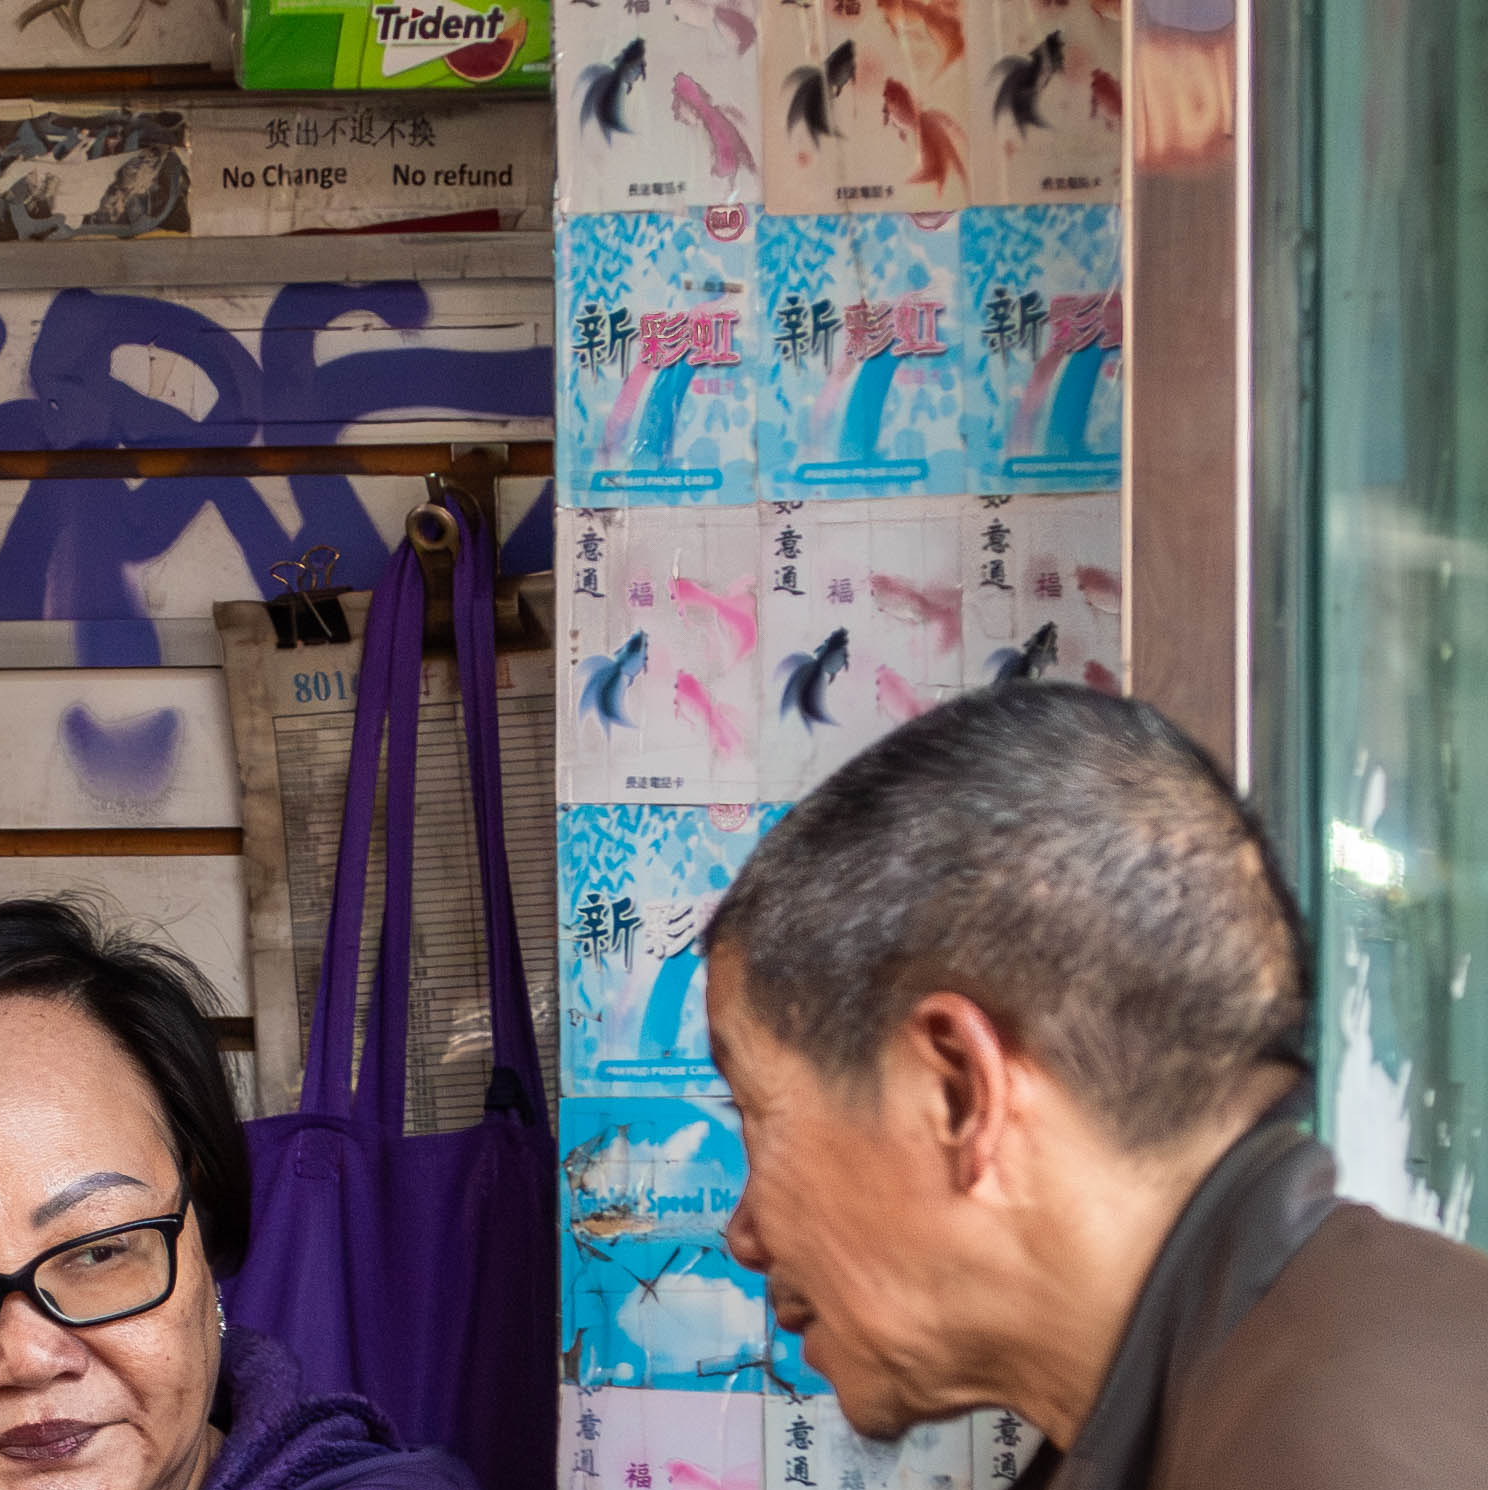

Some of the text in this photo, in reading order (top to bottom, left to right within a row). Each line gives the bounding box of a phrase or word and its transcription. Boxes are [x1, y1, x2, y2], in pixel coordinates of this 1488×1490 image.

[376, 5, 505, 41] Trident
[265, 107, 437, 151] 货出不退不换
[222, 162, 513, 189] No Change No refund
[572, 303, 742, 382] 新彩虹
[774, 295, 948, 374] 新彩虹
[628, 580, 655, 608] 福
[826, 577, 855, 605] 福
[1034, 571, 1063, 600] 福
[572, 1386, 603, 1478] 意通
[624, 1462, 654, 1490] 福
